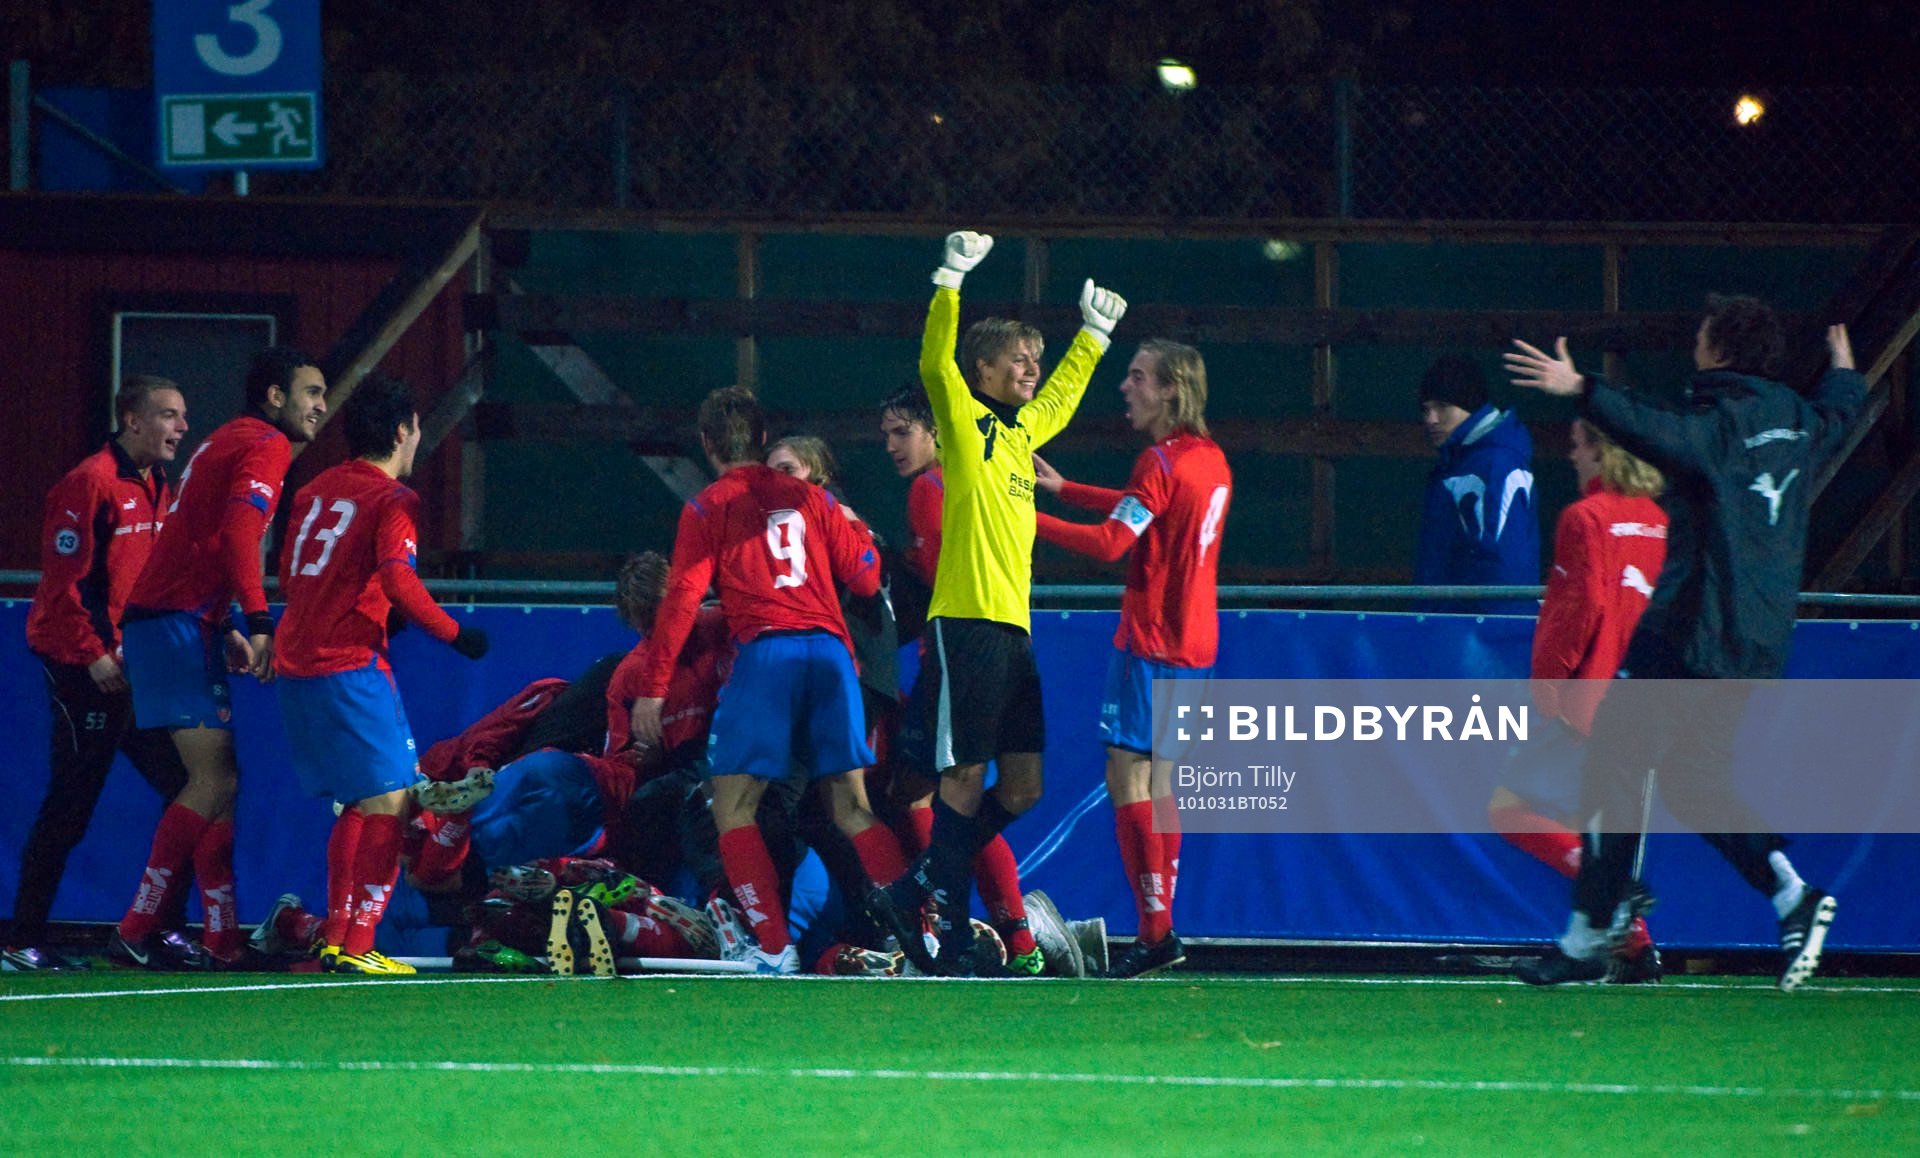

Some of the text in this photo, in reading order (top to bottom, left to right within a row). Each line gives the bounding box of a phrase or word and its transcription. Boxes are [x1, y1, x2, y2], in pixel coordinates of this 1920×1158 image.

[194, 0, 283, 76] 3
[58, 533, 76, 550] 13
[290, 496, 358, 577] 13
[767, 508, 808, 589] 9
[85, 712, 108, 730] 53
